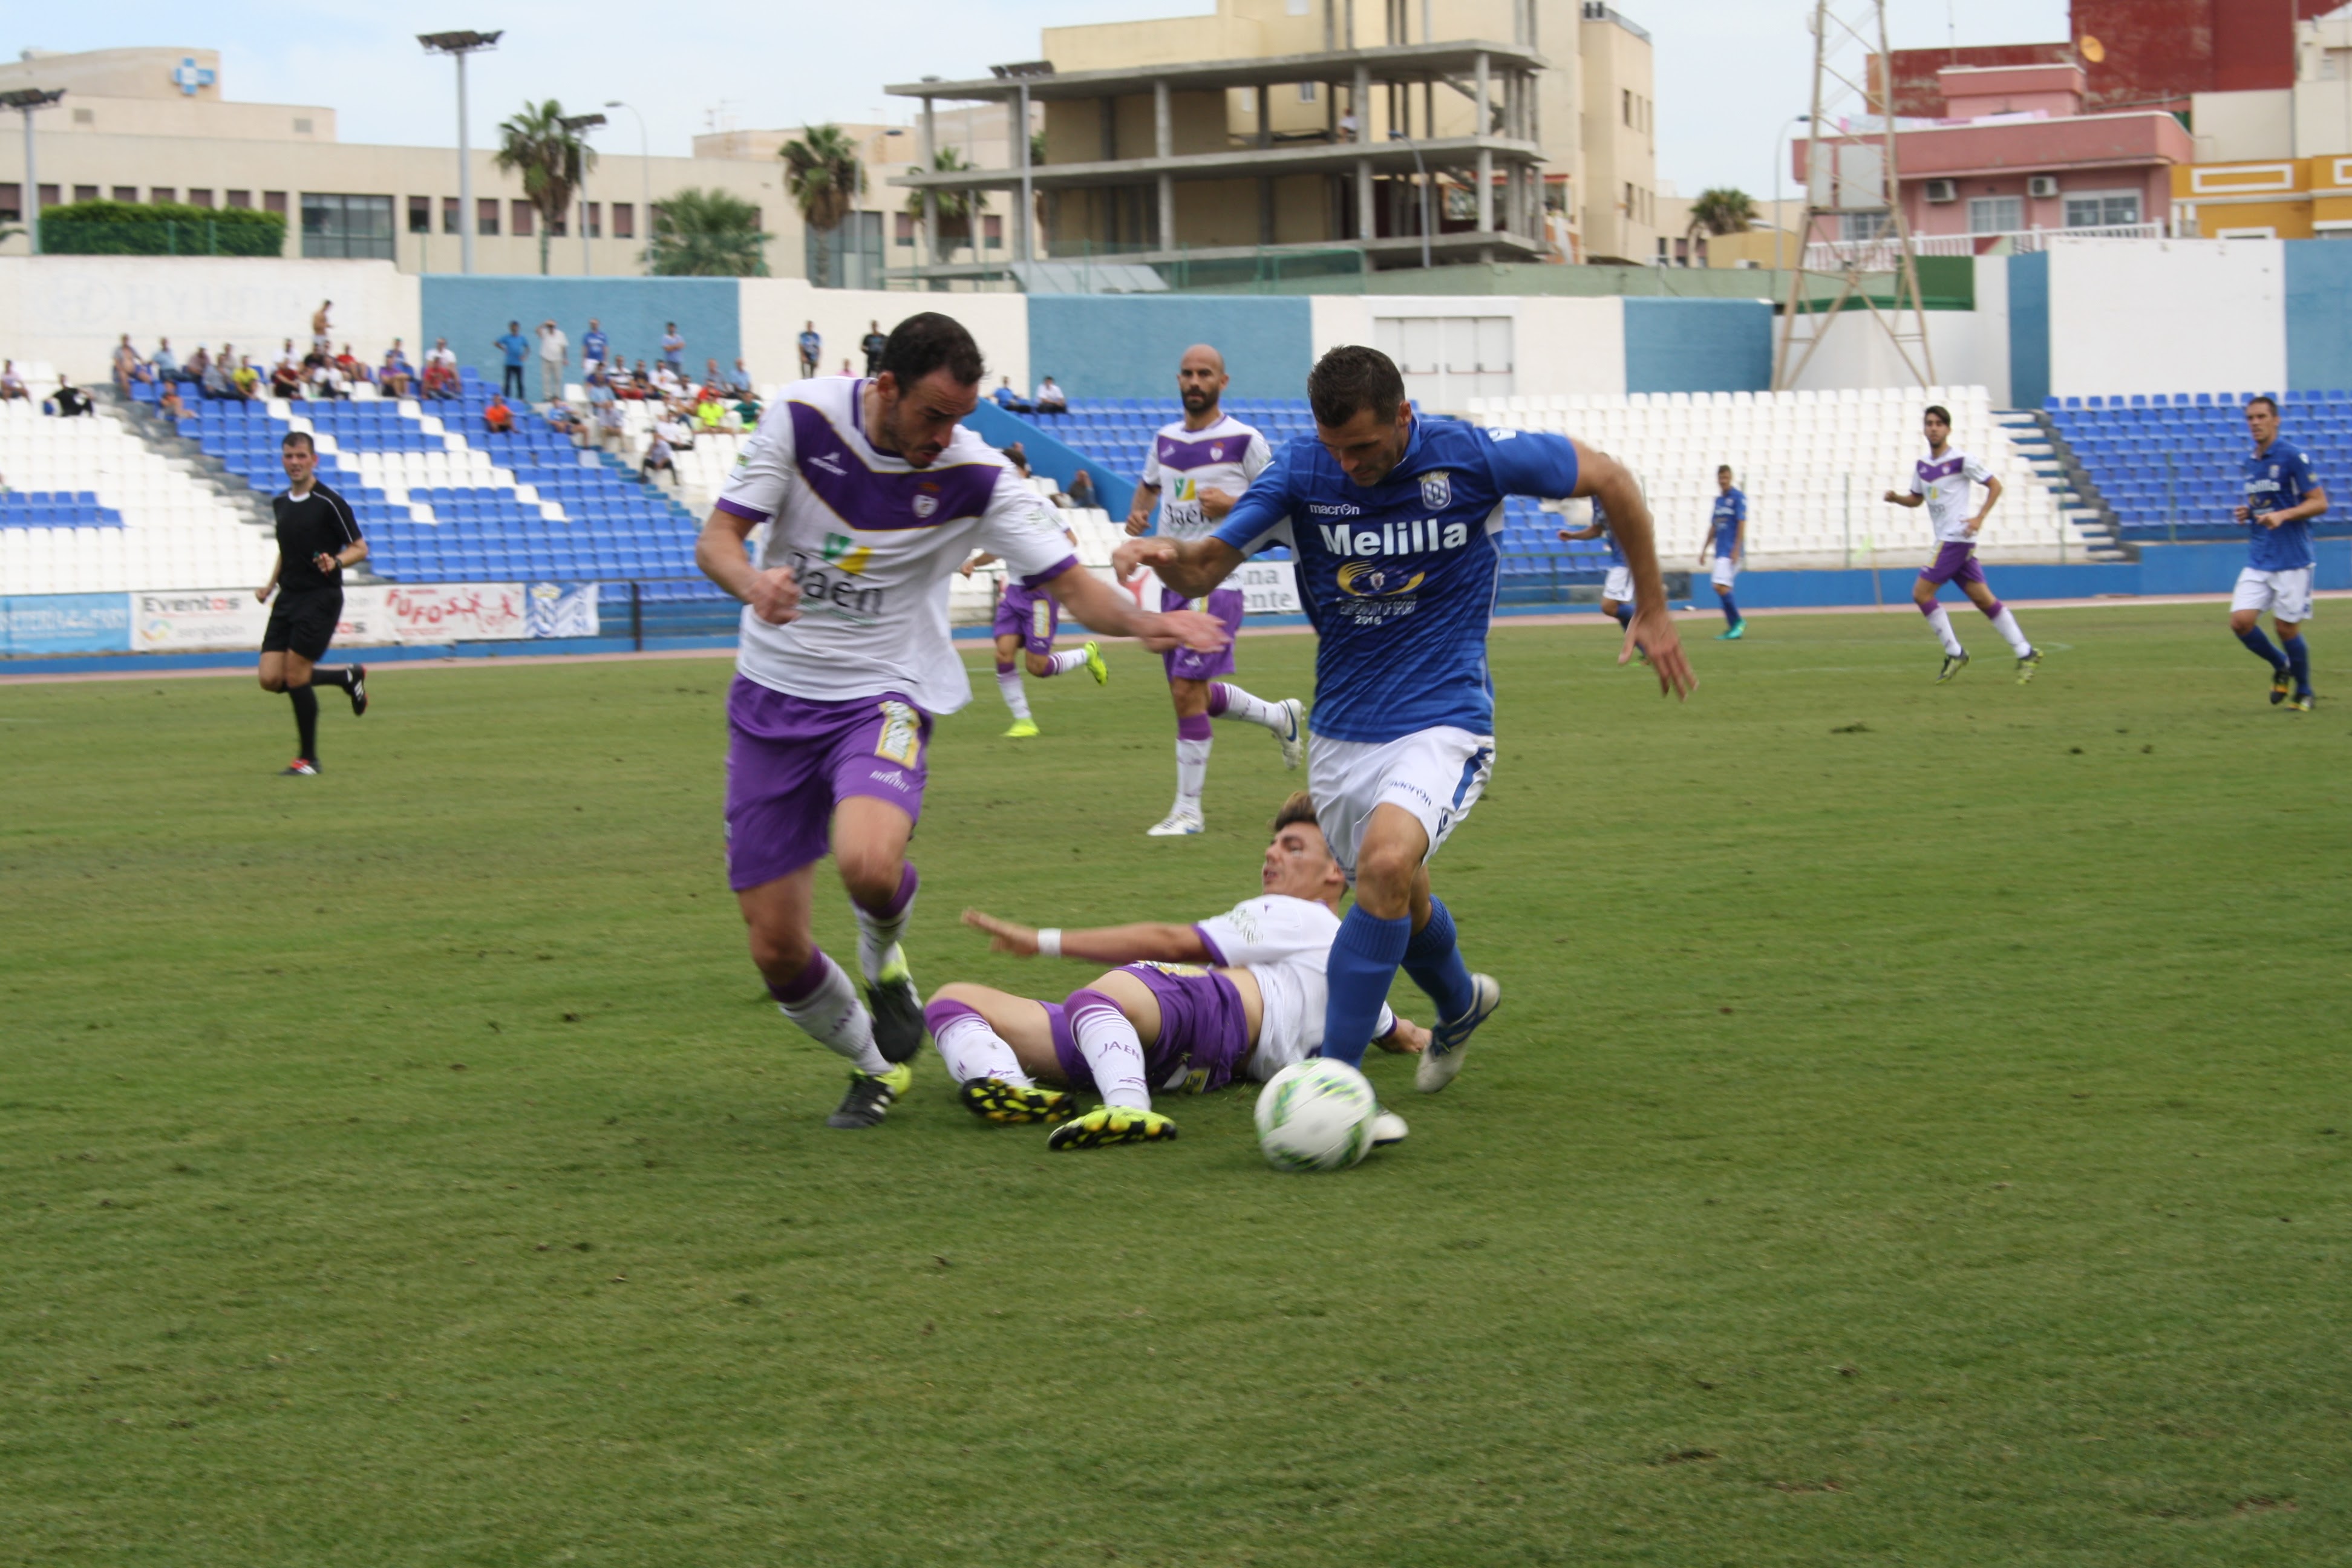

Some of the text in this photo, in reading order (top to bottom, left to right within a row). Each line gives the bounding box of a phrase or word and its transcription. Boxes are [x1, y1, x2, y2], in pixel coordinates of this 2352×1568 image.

[1310, 504, 1360, 515] macron
[1318, 518, 1468, 556] Melilla
[142, 595, 241, 612] Eventos
[1354, 615, 1382, 625] 2016
